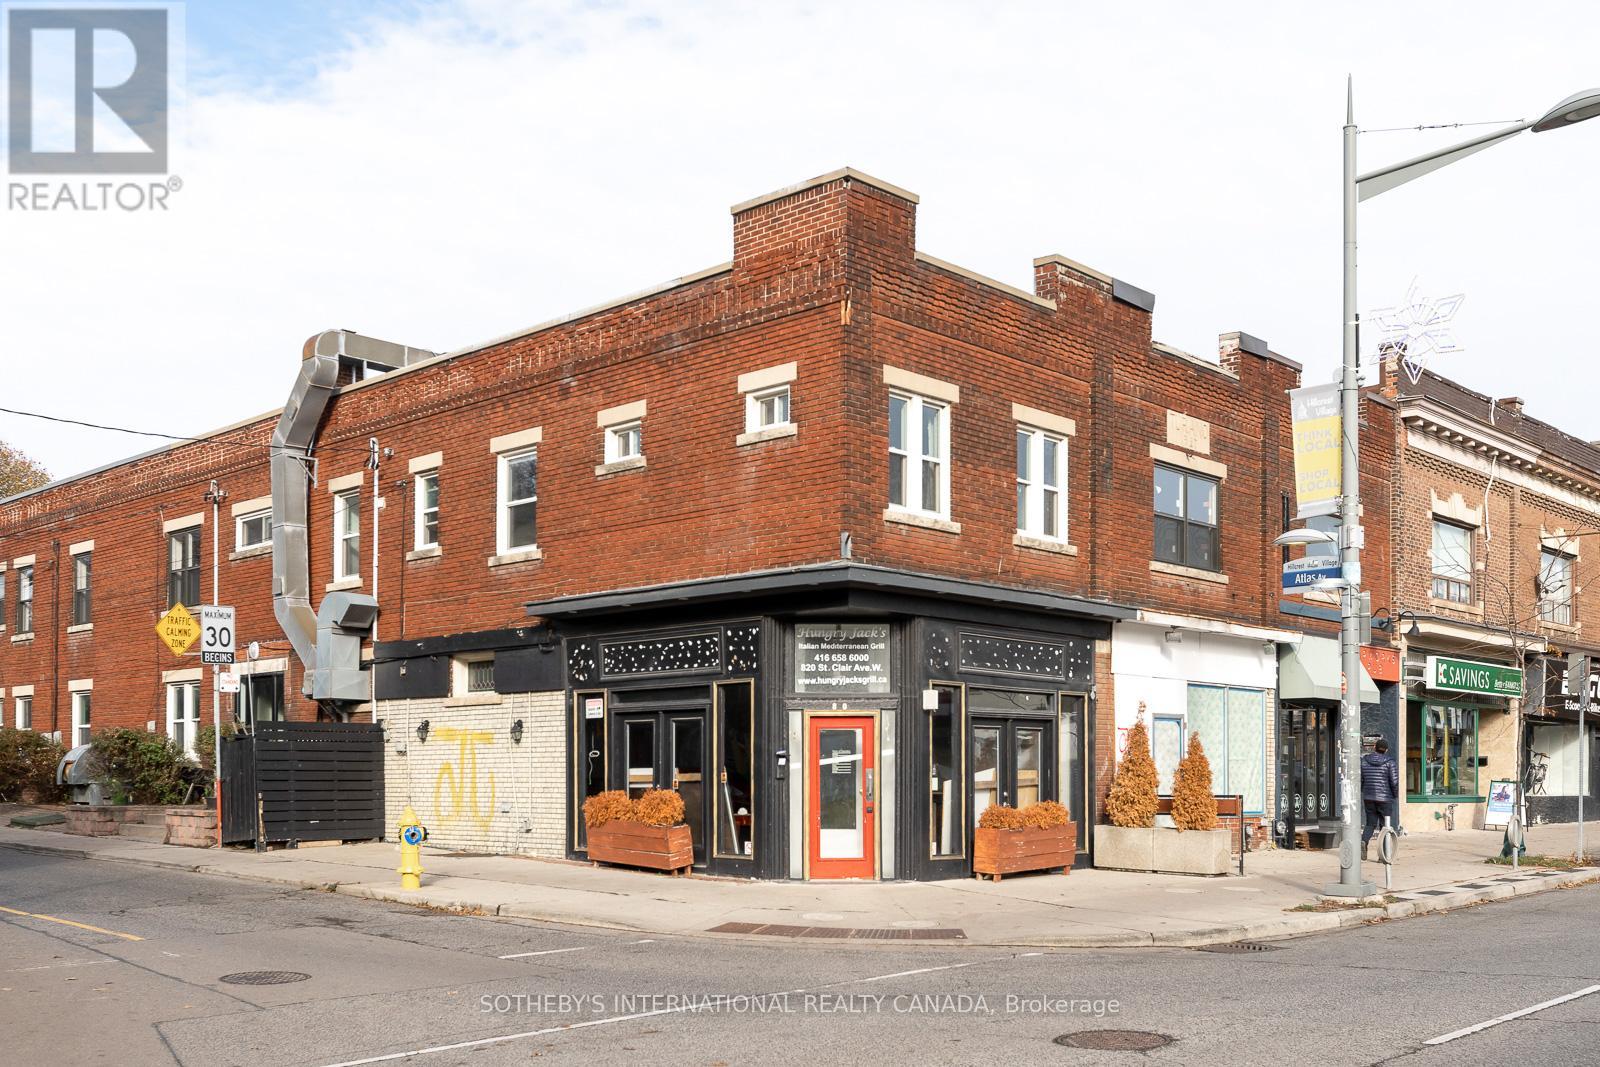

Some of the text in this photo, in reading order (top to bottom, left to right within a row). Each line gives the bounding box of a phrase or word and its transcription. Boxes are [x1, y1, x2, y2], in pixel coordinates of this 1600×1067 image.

[1297, 429, 1332, 442] THINK
[1298, 438, 1340, 453] LOCAL
[1299, 469, 1329, 482] SHOP
[1300, 479, 1340, 493] LOCAL
[1295, 572, 1316, 584] Atlas
[167, 615, 191, 626] TRAFFIC
[204, 611, 232, 620] MAXIMUM
[166, 627, 192, 638] CALMING
[205, 626, 231, 648] 30
[797, 626, 887, 641] Hungry Jack's
[171, 638, 186, 649] ZONE
[798, 642, 820, 650] Italian
[870, 642, 885, 650] Grill
[204, 652, 233, 663] BEGINS
[814, 653, 870, 662] 416 658 6000
[800, 663, 816, 672] 820
[817, 663, 831, 672] St.
[831, 663, 852, 672] Clair
[1449, 666, 1490, 689] SAVINGS
